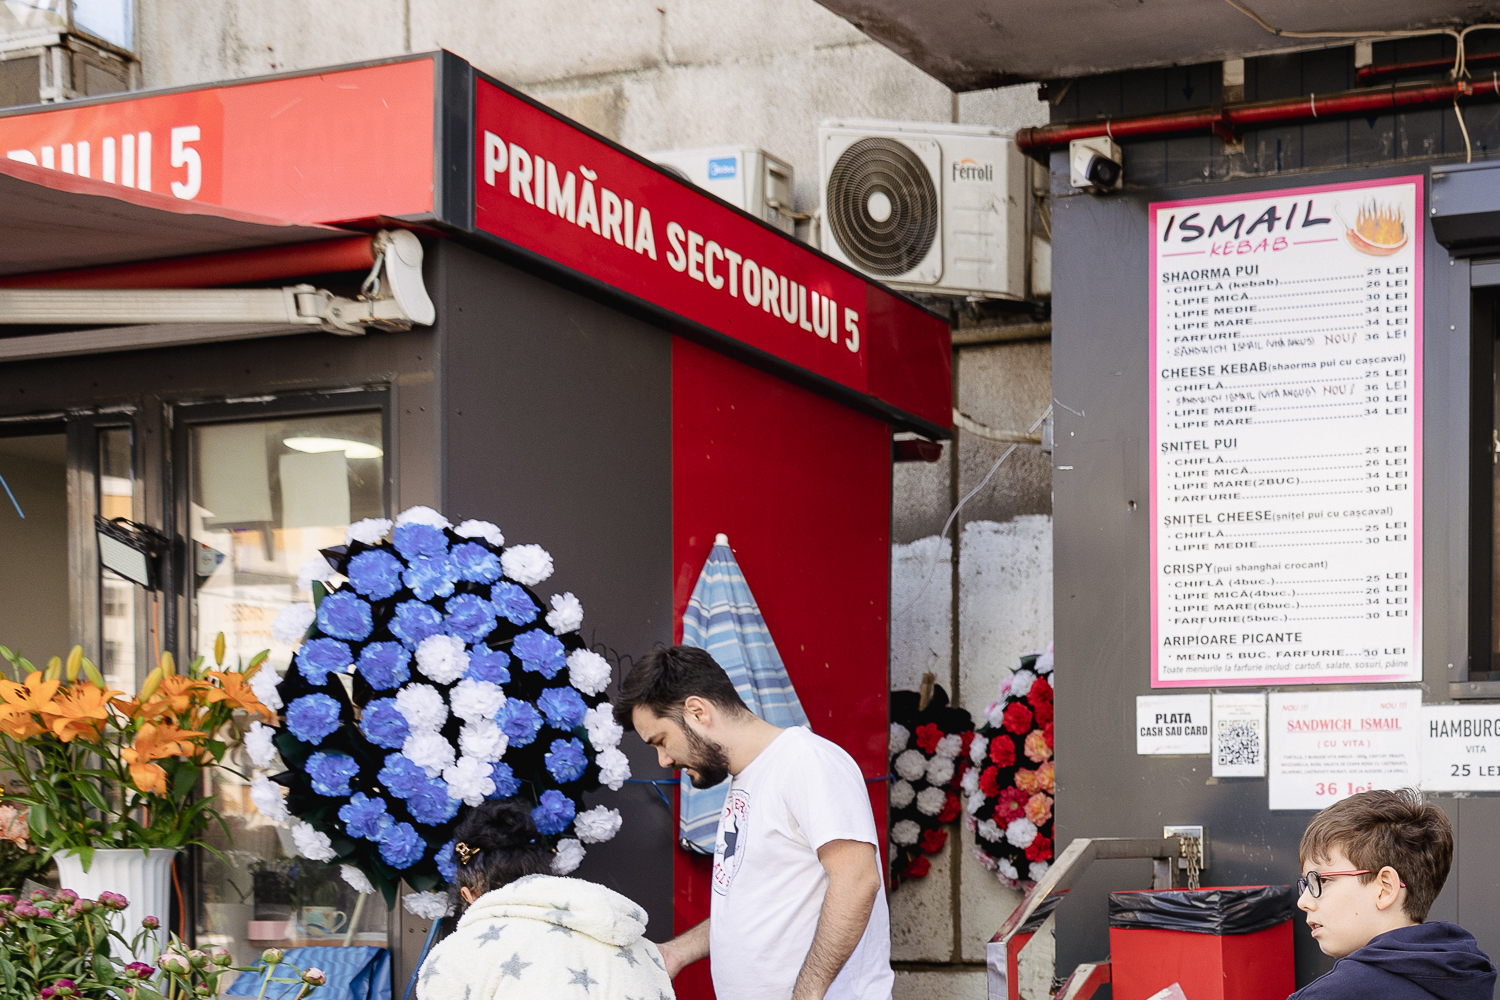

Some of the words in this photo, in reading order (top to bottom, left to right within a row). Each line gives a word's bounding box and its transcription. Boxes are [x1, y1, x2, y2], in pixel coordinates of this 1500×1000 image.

[170, 125, 202, 201] 5
[952, 162, 993, 182] Ferroli
[1163, 199, 1331, 242] ISMAIL
[483, 129, 658, 262] PRIMĂRIA
[665, 220, 838, 345] SECTORULUI
[844, 306, 860, 354] 5
[1210, 236, 1288, 258] KEBAB
[1162, 267, 1231, 283] SHAORMA
[1236, 264, 1259, 276] PUI
[1229, 279, 1279, 290] (kebab)
[1387, 266, 1408, 275] LEI
[1174, 297, 1209, 306] LIPIE
[1386, 280, 1407, 288] LEI
[1174, 309, 1209, 319] LIPIE
[1214, 305, 1257, 315] MEDIE
[1386, 292, 1407, 300] LEI
[1174, 321, 1209, 331] LIPIE
[1214, 318, 1253, 328] MARE
[1386, 305, 1407, 313] LEI
[1174, 332, 1241, 343] FARFURIE
[1386, 318, 1407, 326] LEI
[1161, 365, 1215, 379] CHEESE
[1320, 358, 1335, 370] pui
[1339, 358, 1352, 367] cu
[1386, 369, 1407, 377] LEI
[1174, 408, 1209, 417] LIPIE
[1214, 405, 1257, 414] MEDIE
[1386, 394, 1407, 403] LEI
[1174, 420, 1209, 429] LIPIE
[1214, 417, 1253, 427] MARE
[1386, 407, 1407, 415] LEI
[1215, 438, 1237, 449] PUI
[1386, 445, 1406, 453] LEI
[1174, 470, 1209, 478] LIPIE
[1386, 458, 1406, 466] LEI
[1174, 482, 1208, 491] LIPIE
[1174, 493, 1241, 502] FARFURIE
[1386, 483, 1407, 491] LEI
[1308, 510, 1323, 520] pui
[1327, 510, 1339, 518] cu
[1386, 521, 1406, 529] LEI
[1175, 543, 1209, 552] LIPIE
[1215, 541, 1257, 550] MEDIE
[1236, 562, 1281, 572] shanghai
[1284, 560, 1328, 570] crocant)
[1229, 578, 1275, 587] (4buc.)
[1174, 592, 1209, 600] LIPIE
[1174, 605, 1209, 613] LIPIE
[1386, 597, 1407, 605] LEI
[1163, 634, 1237, 646] ARIPIOARE
[1242, 632, 1303, 644] PICANTE
[1176, 653, 1221, 661] MENIU
[1226, 652, 1233, 660] 5
[1238, 651, 1271, 659] BUC.
[1276, 649, 1345, 658] FARFURIE
[1384, 647, 1406, 655] LEI
[1162, 665, 1183, 675] Toate
[1185, 664, 1222, 673] meniurile
[1224, 663, 1231, 672] la
[1233, 662, 1263, 673] farfurie
[1155, 713, 1192, 724] PLATA
[1287, 719, 1352, 732] SANDWICH
[1361, 718, 1402, 730] ISMAIL
[1140, 726, 1163, 736] CASH
[1166, 726, 1182, 736] SAU
[1184, 726, 1208, 736] CARD
[1466, 745, 1486, 753] VITA
[1451, 764, 1471, 776] 25
[1315, 782, 1338, 796] 36
